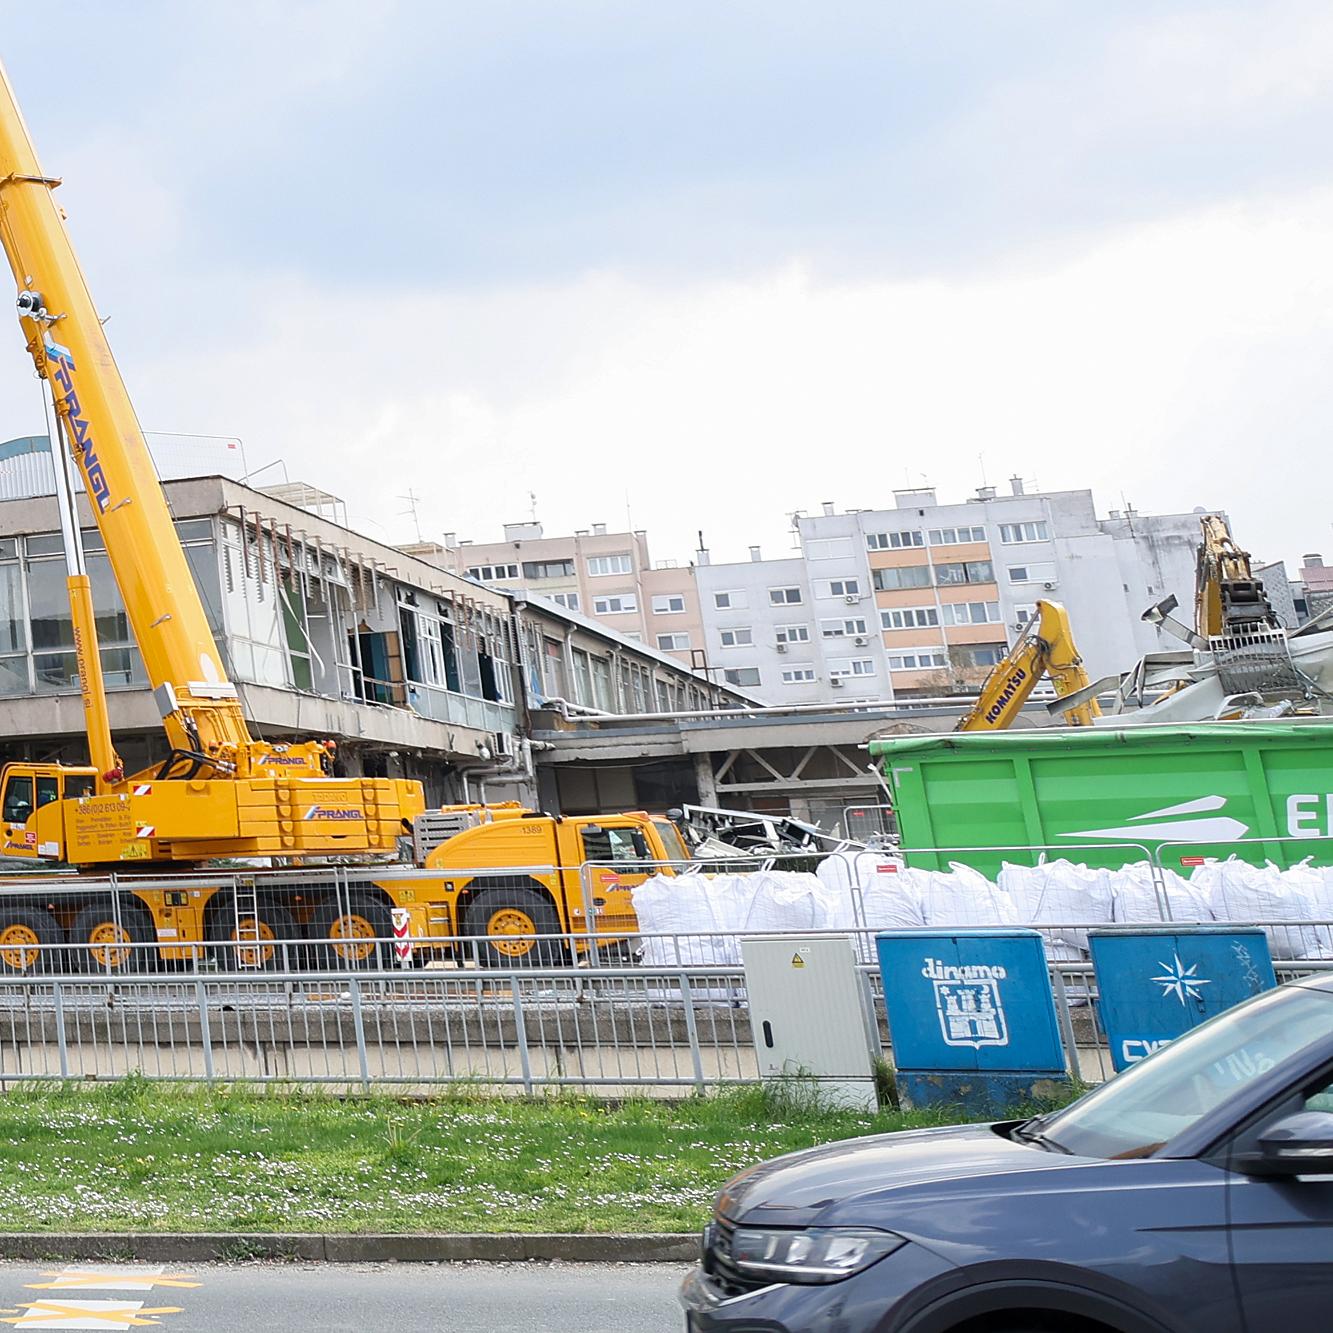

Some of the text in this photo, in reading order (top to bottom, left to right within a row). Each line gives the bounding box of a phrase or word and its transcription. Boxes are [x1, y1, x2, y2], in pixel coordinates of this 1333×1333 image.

[51, 354, 110, 515] PRANGL
[985, 668, 1026, 724] KOMATSU
[265, 757, 307, 765] PRANGL
[315, 808, 364, 819] PRANGL
[1287, 794, 1333, 837] E
[921, 958, 1007, 980] dinamo
